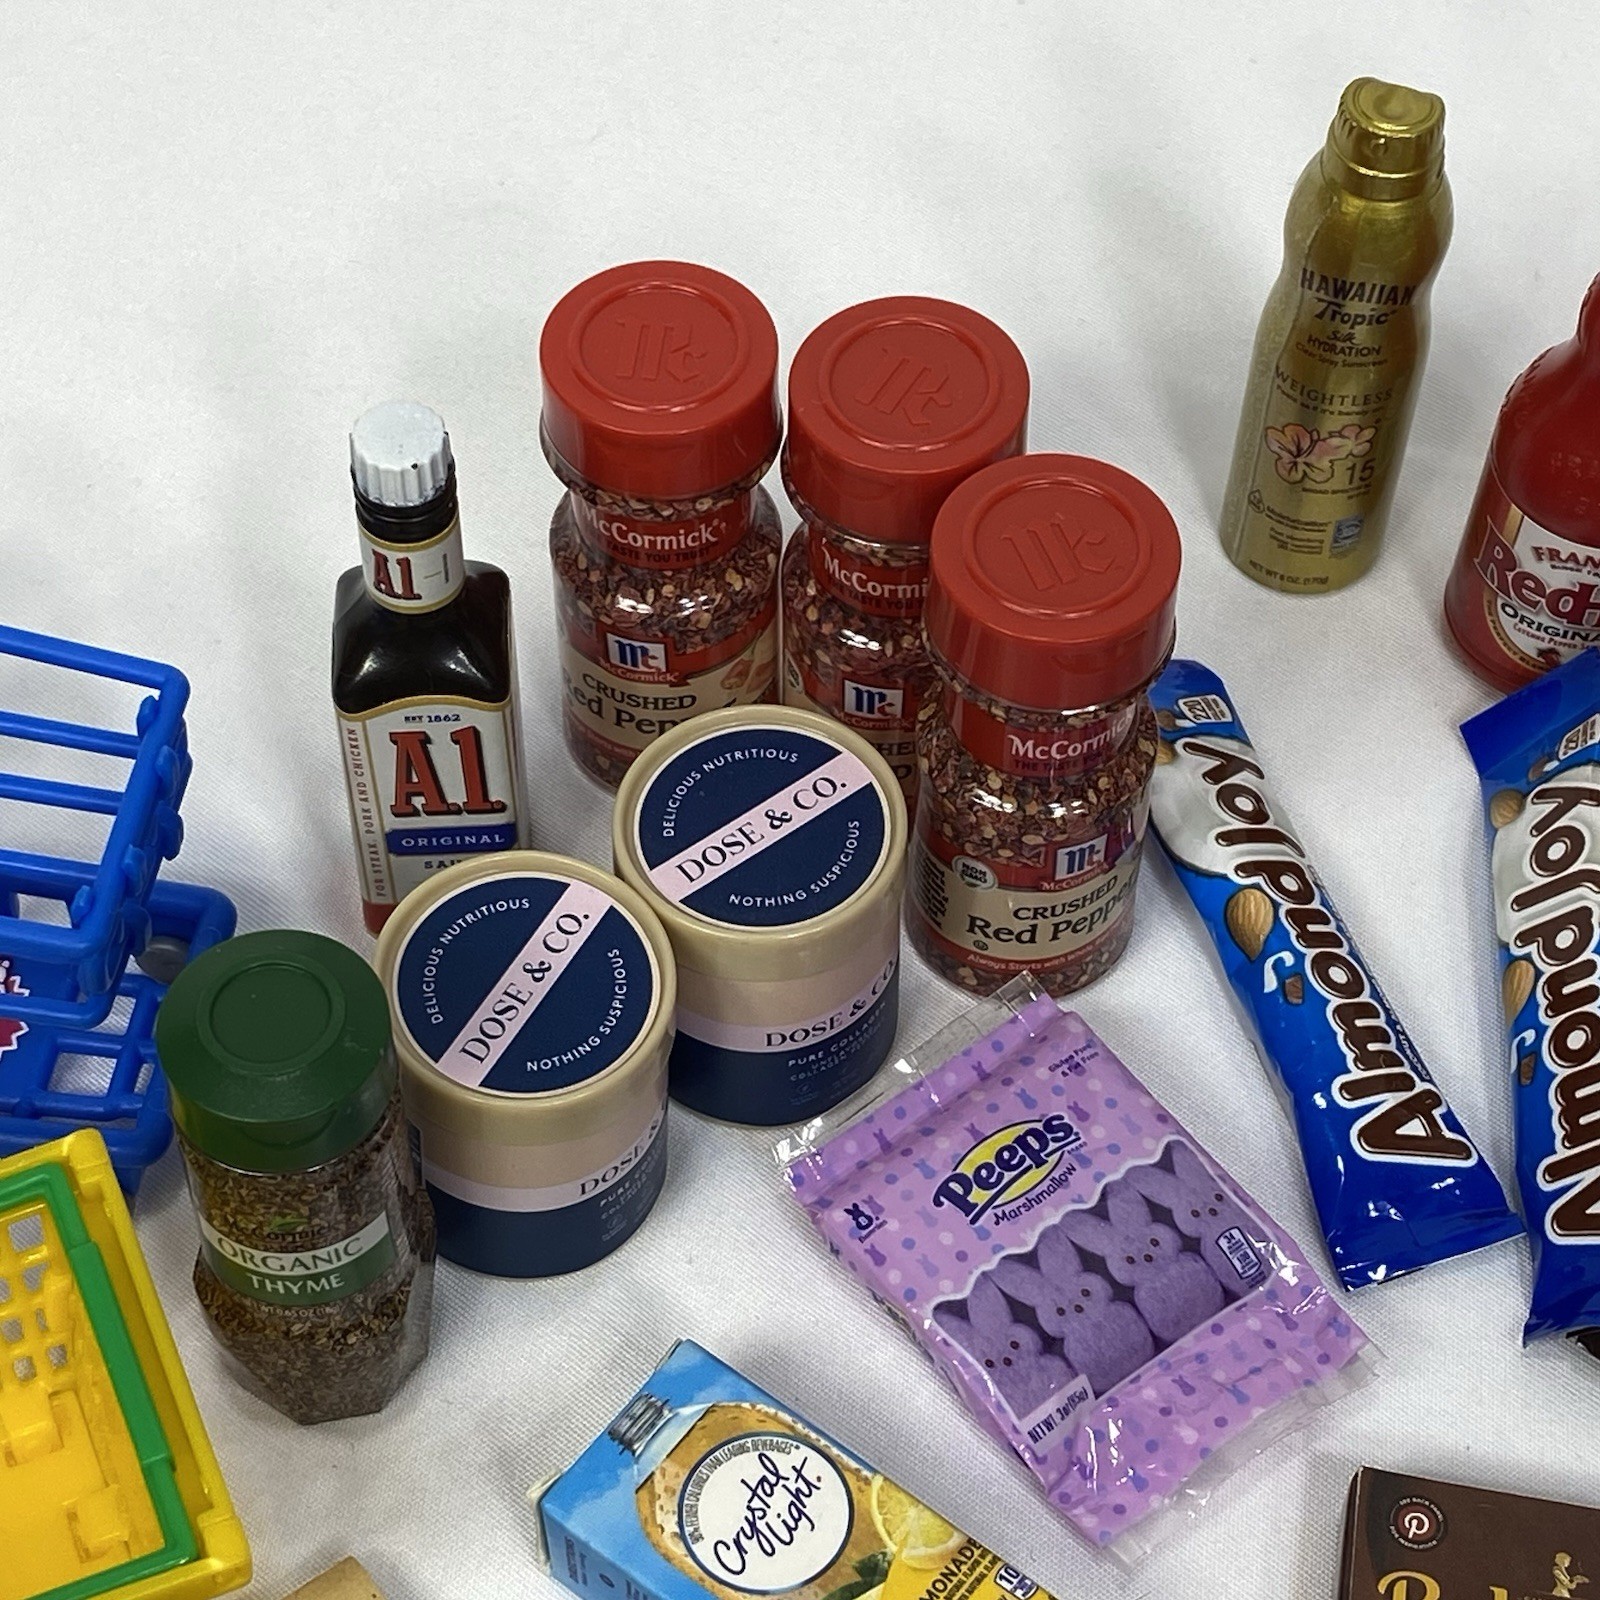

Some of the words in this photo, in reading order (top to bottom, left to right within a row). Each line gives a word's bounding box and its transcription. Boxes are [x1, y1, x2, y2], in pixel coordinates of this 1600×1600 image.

[1300, 268, 1416, 306] HAWAIIAN
[1315, 297, 1390, 330] Tropic
[1307, 333, 1381, 357] HYDRATION
[1327, 330, 1360, 345] Silk
[1341, 358, 1388, 368] Sunscreen
[1275, 364, 1393, 407] WEIGHTLESS
[1346, 457, 1375, 485] 15
[582, 674, 697, 711] CRUSHED
[426, 713, 461, 723] 1862
[346, 728, 366, 776] CHICKEN
[358, 778, 368, 800] AND
[662, 771, 702, 838] DELICIOUS
[701, 748, 799, 773] NUTRITIOUS
[1181, 740, 1307, 860] Joy
[362, 803, 374, 833] PORK
[675, 820, 765, 884] DOSE
[764, 808, 793, 830] &
[792, 776, 847, 810] CO.
[401, 833, 505, 848] ORIGINAL
[728, 889, 808, 908] NOTHING
[810, 819, 860, 894] SUSPICIOUS
[375, 875, 387, 899] FOR
[1013, 875, 1118, 921] CRUSHED
[966, 914, 1038, 945] Red
[422, 947, 444, 1024] DELICIOUS
[439, 897, 531, 945] NUTRITIOUS
[967, 953, 1007, 971] Always
[1008, 962, 1042, 971] Starts
[459, 982, 534, 1064] DOSE
[522, 960, 552, 983] &
[542, 912, 590, 954] CO.
[526, 1035, 601, 1072] NOTHING
[600, 948, 627, 1035] SUSPICIOUS
[766, 1012, 843, 1047] DOSE
[849, 999, 867, 1017] &
[1231, 857, 1475, 1163] Almond
[788, 1050, 824, 1067] PURE
[933, 1114, 1078, 1224] Peeps
[993, 1163, 1078, 1226] Marshmallow
[217, 1237, 363, 1272] ORGANIC
[246, 1273, 345, 1295] THYME
[299, 1308, 315, 1318] OZ
[704, 1455, 724, 1474] THAN
[720, 1440, 751, 1461] LEADING
[713, 1452, 790, 1576] Crystal
[765, 1456, 821, 1546] Light
[999, 1565, 1021, 1586] 10
